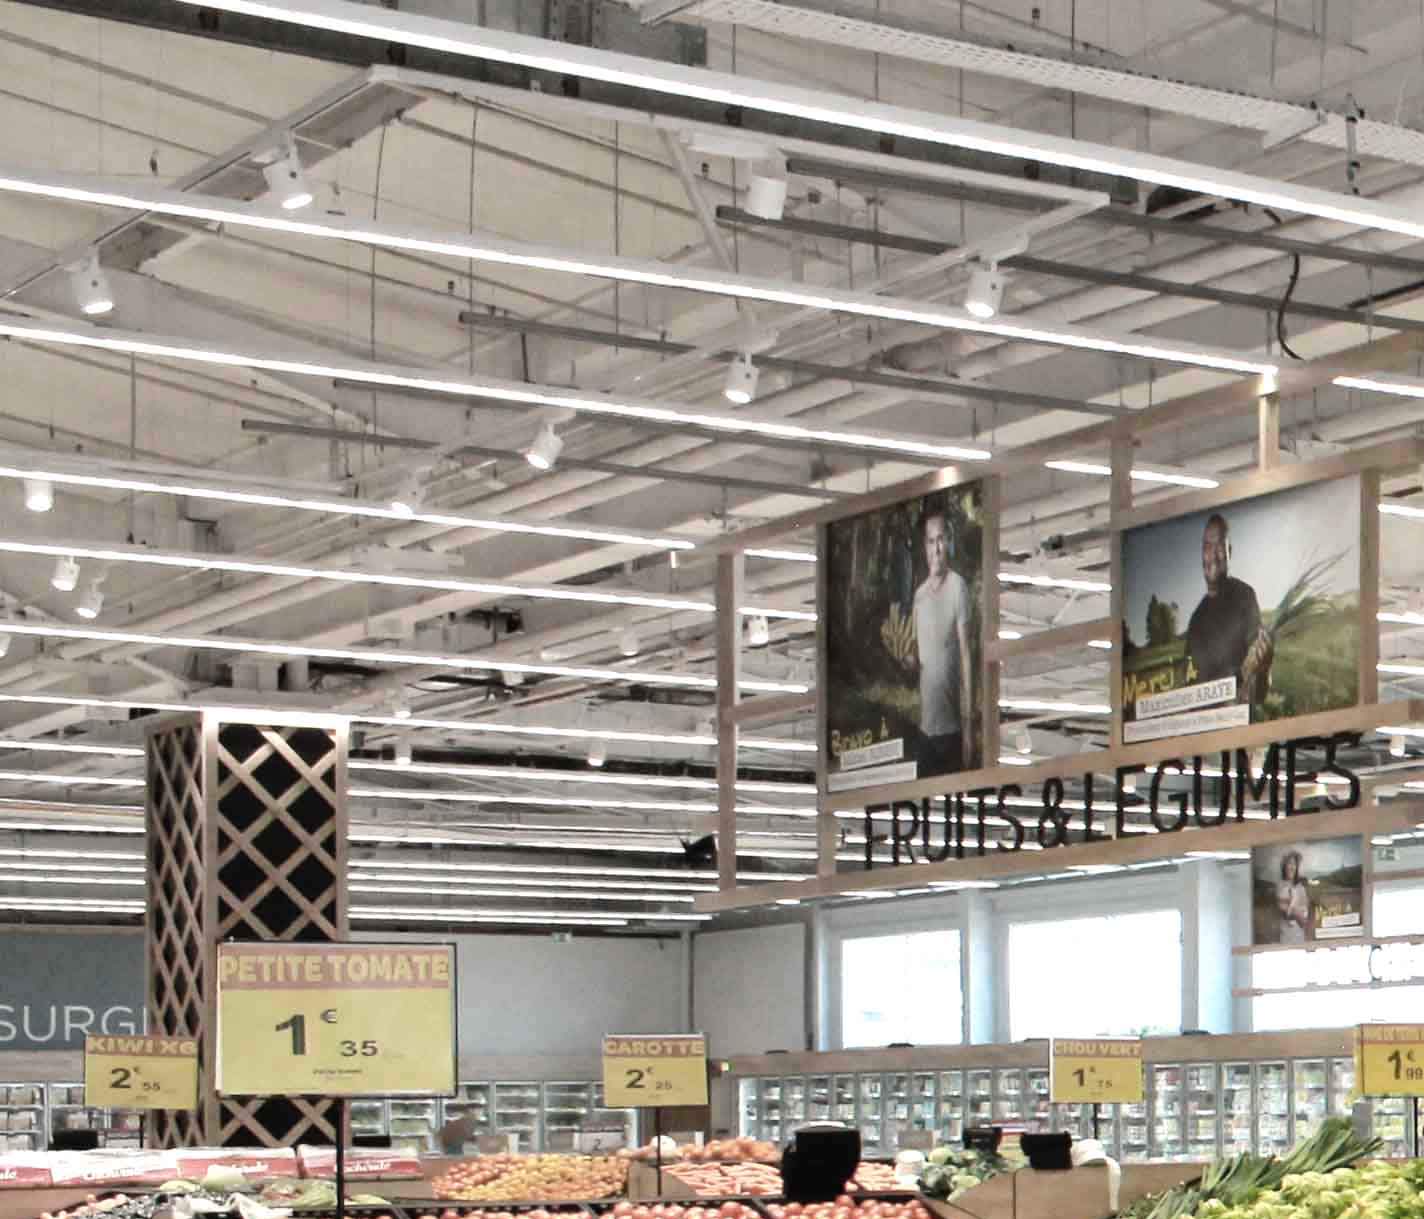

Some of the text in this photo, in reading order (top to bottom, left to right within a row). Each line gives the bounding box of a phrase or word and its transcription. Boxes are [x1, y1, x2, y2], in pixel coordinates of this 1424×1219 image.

[865, 784, 1024, 870] FRUITS
[1041, 776, 1071, 849] &
[221, 953, 450, 983] PETITE TOMATE
[88, 1036, 153, 1053] KIWI
[275, 1014, 307, 1056] 1
[340, 1040, 379, 1057] 35
[604, 1040, 704, 1055] CAROTTE
[1387, 1049, 1402, 1080] 1
[109, 1067, 132, 1089] 2
[625, 1069, 646, 1089] 2
[1072, 1068, 1085, 1088] 1
